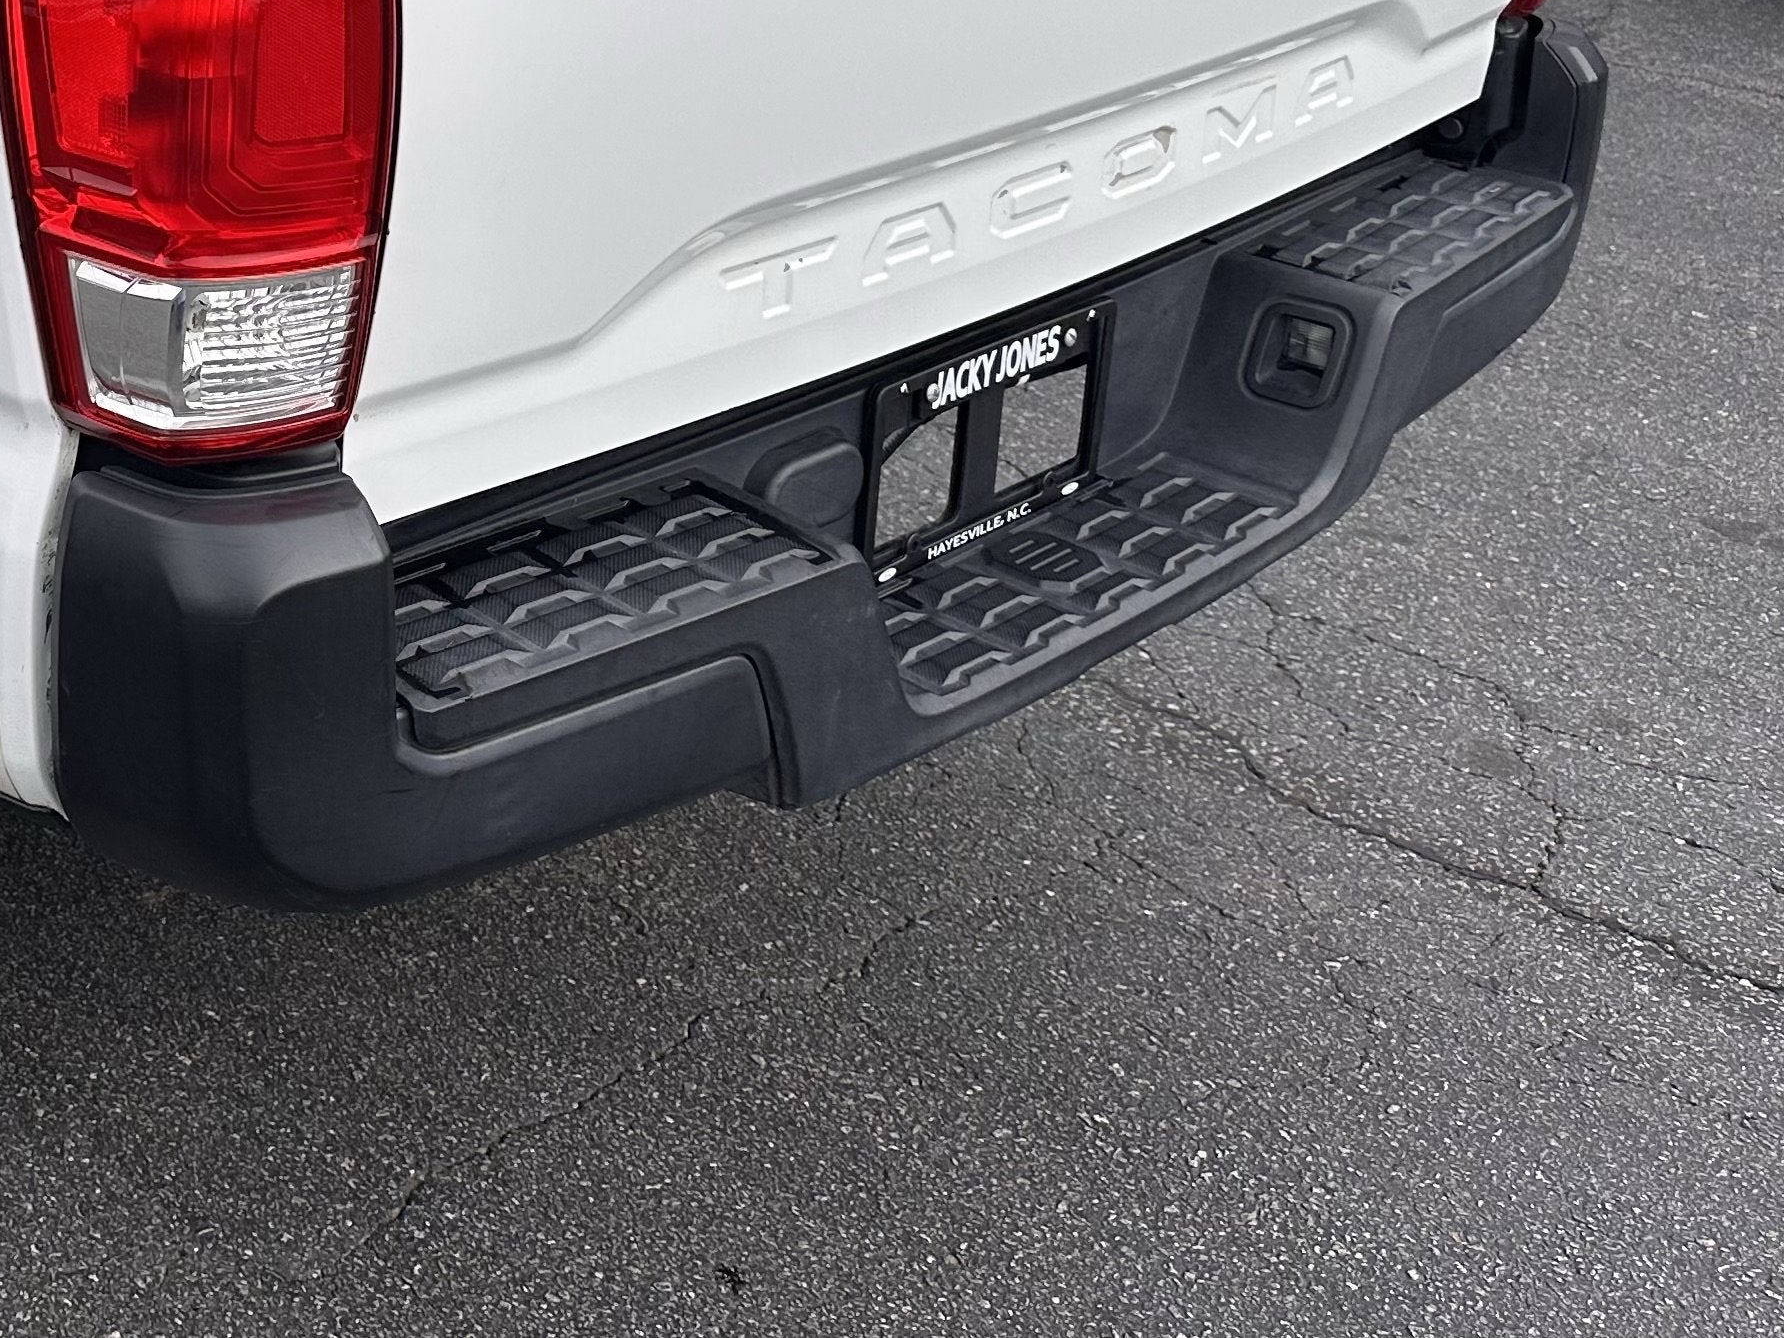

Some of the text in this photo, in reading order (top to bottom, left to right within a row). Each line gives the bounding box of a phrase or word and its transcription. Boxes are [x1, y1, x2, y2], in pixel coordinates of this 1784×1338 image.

[718, 54, 1355, 319] TACOMA
[931, 324, 1062, 410] JACKY JONES
[1006, 502, 1032, 523] N.C.
